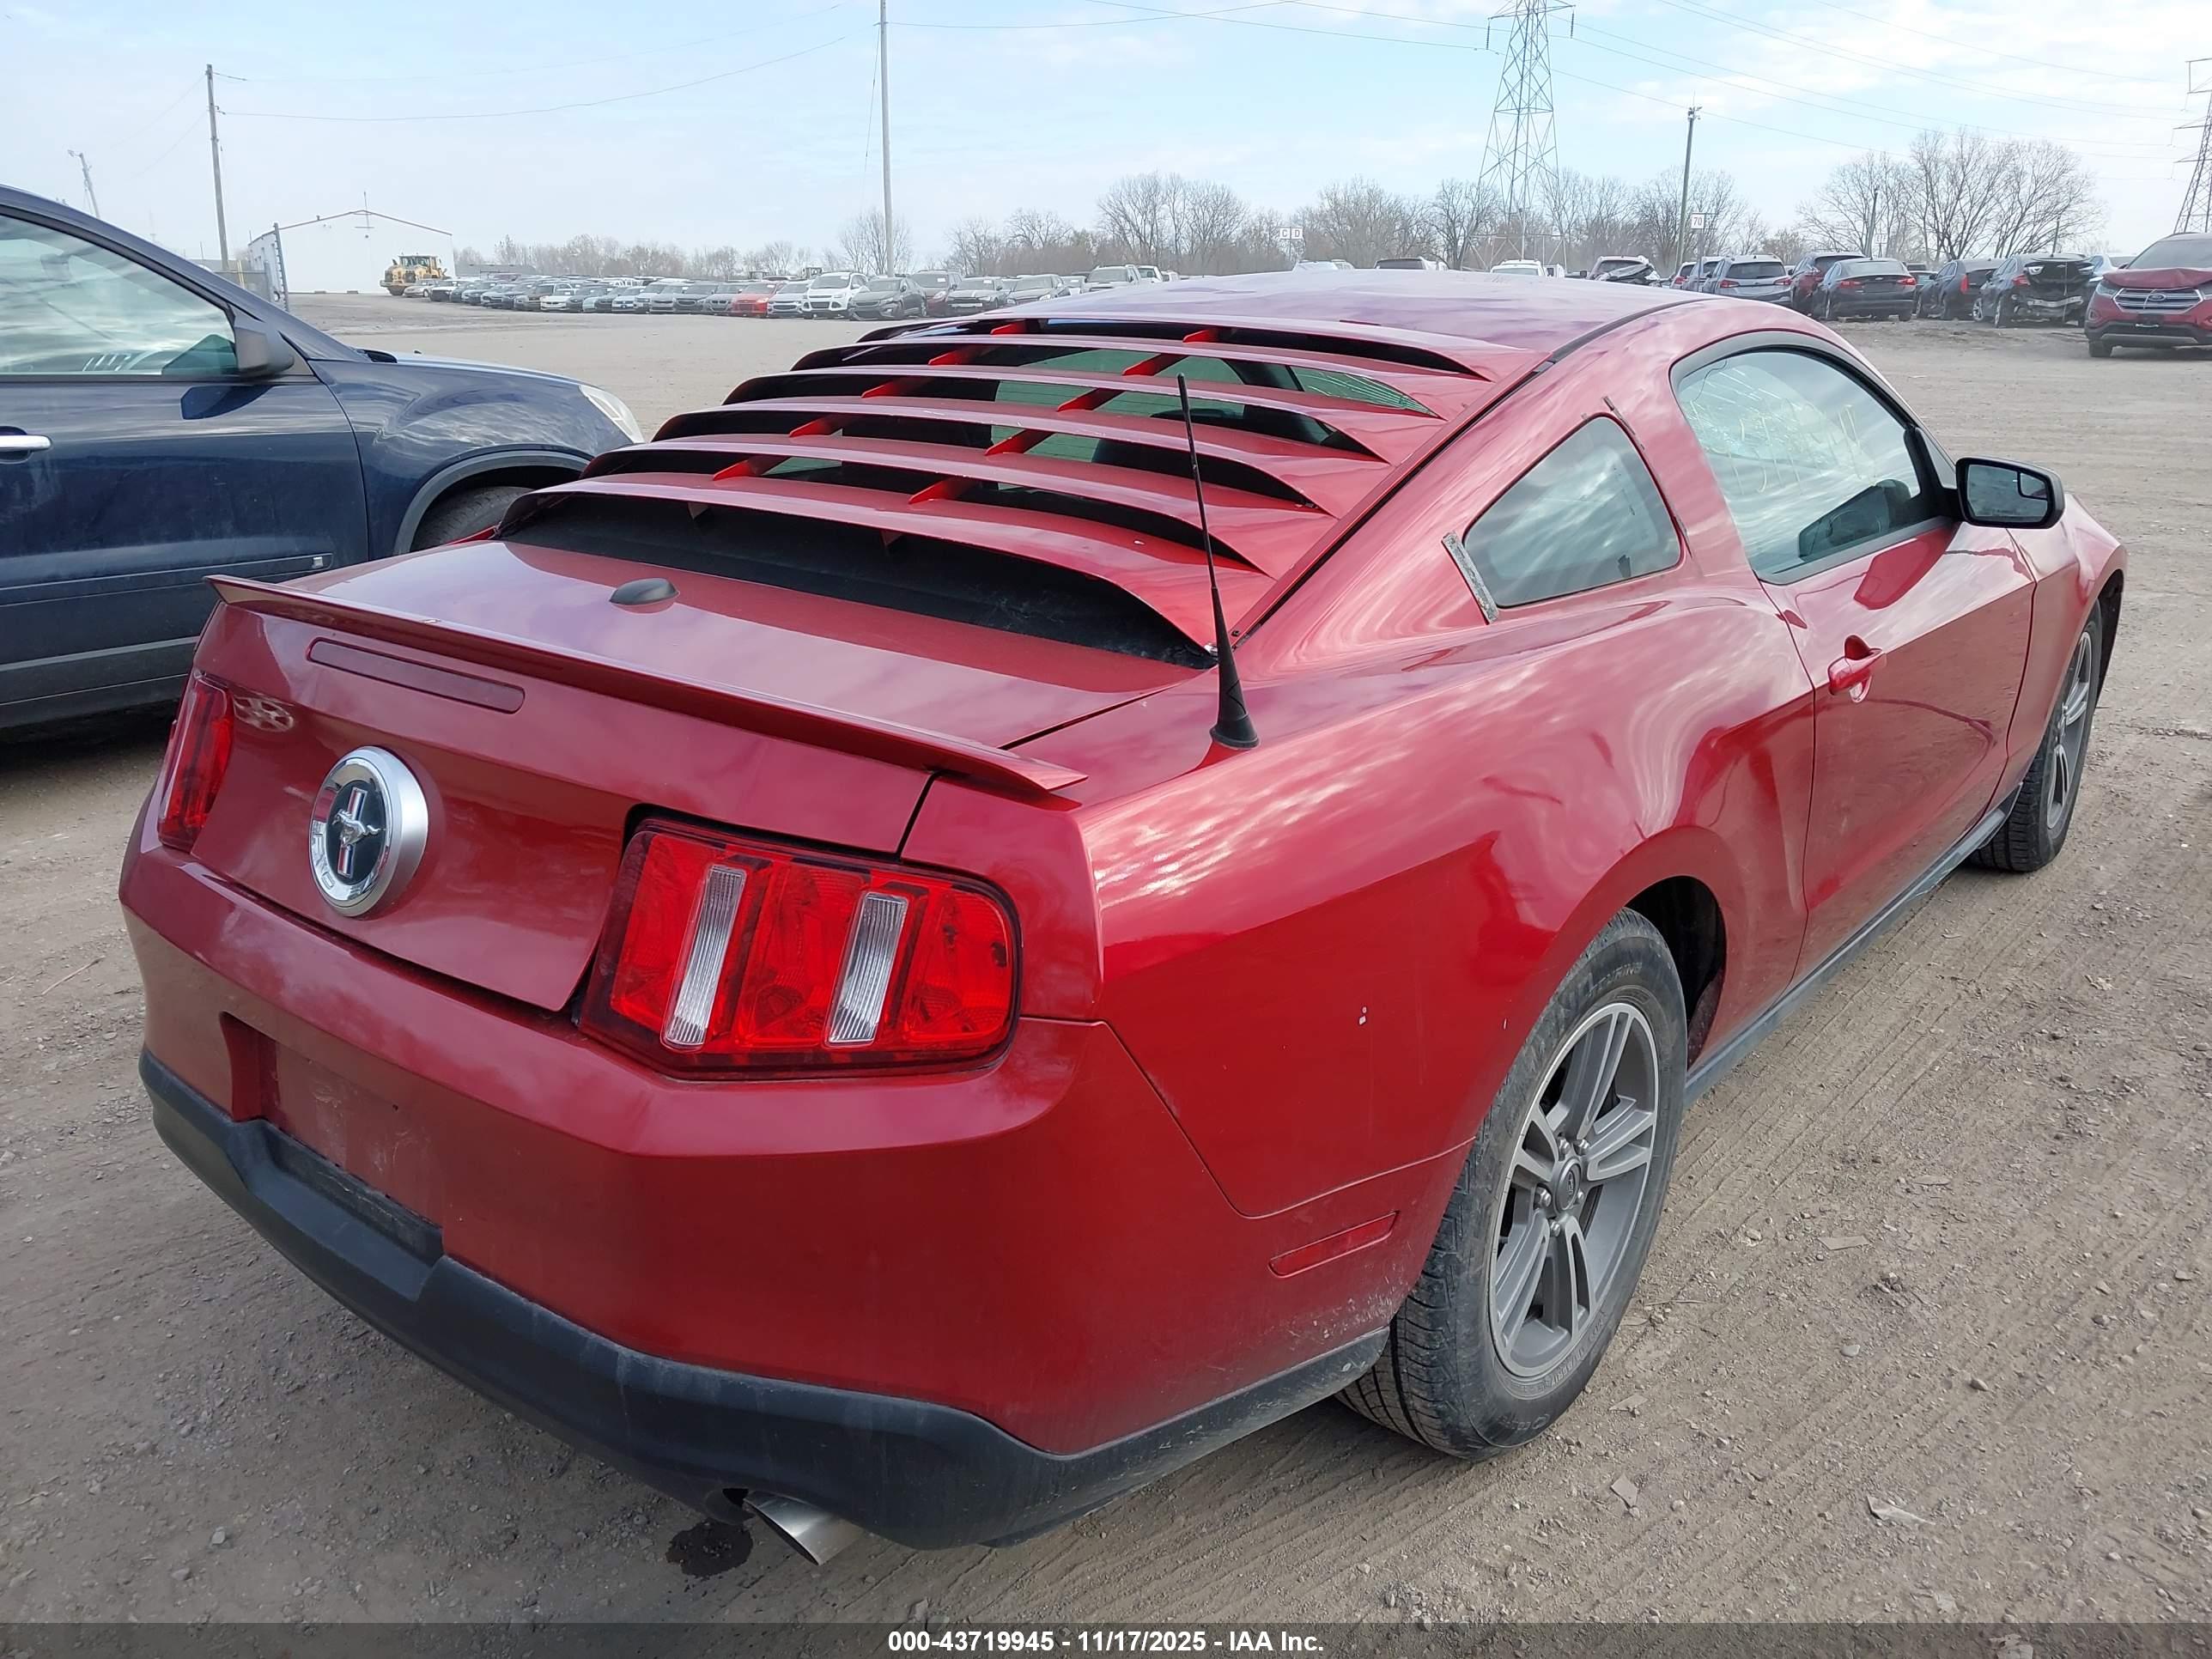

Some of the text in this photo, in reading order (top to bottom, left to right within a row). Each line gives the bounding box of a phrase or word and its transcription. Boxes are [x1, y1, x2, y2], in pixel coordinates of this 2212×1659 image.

[1693, 216, 1703, 226] 70
[1282, 229, 1300, 238] C D
